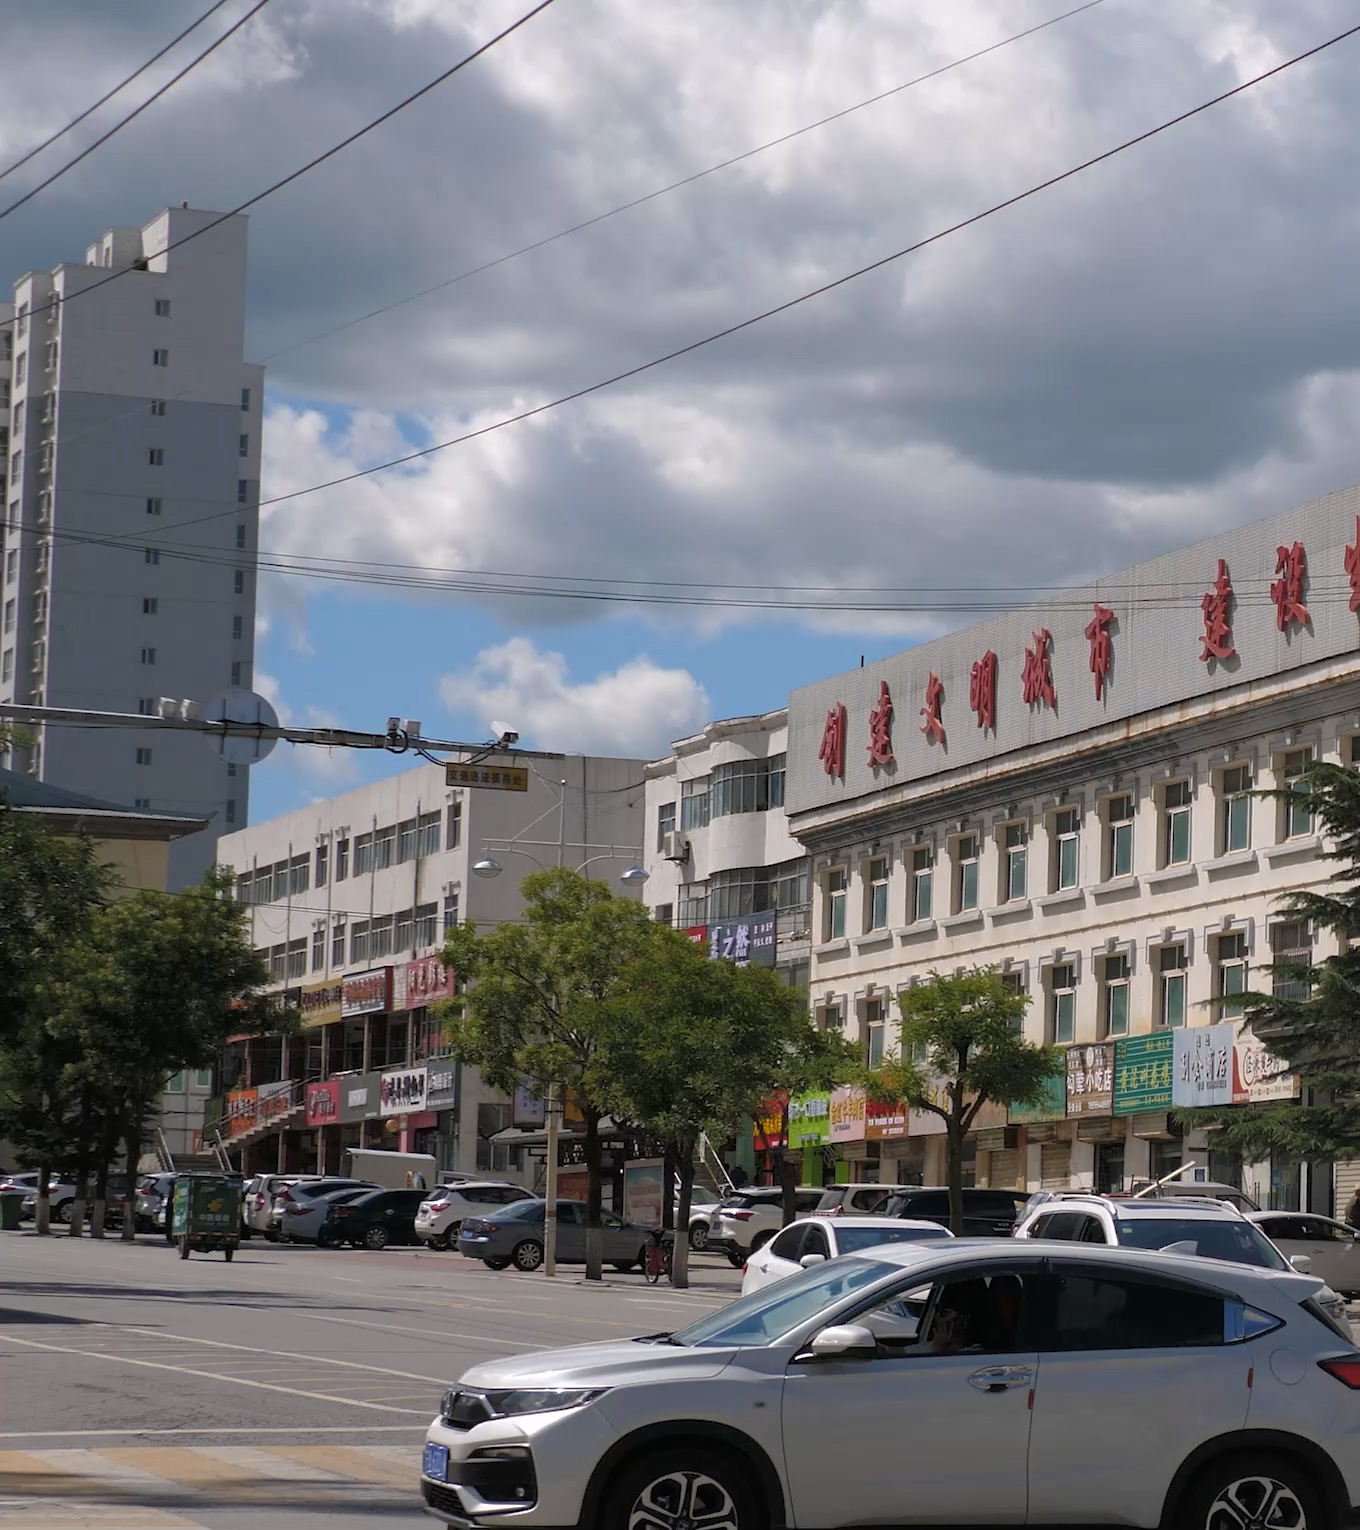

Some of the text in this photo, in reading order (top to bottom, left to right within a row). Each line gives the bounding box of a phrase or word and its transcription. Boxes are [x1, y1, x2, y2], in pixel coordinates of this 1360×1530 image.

[819, 603, 1116, 777] 创建文明城市
